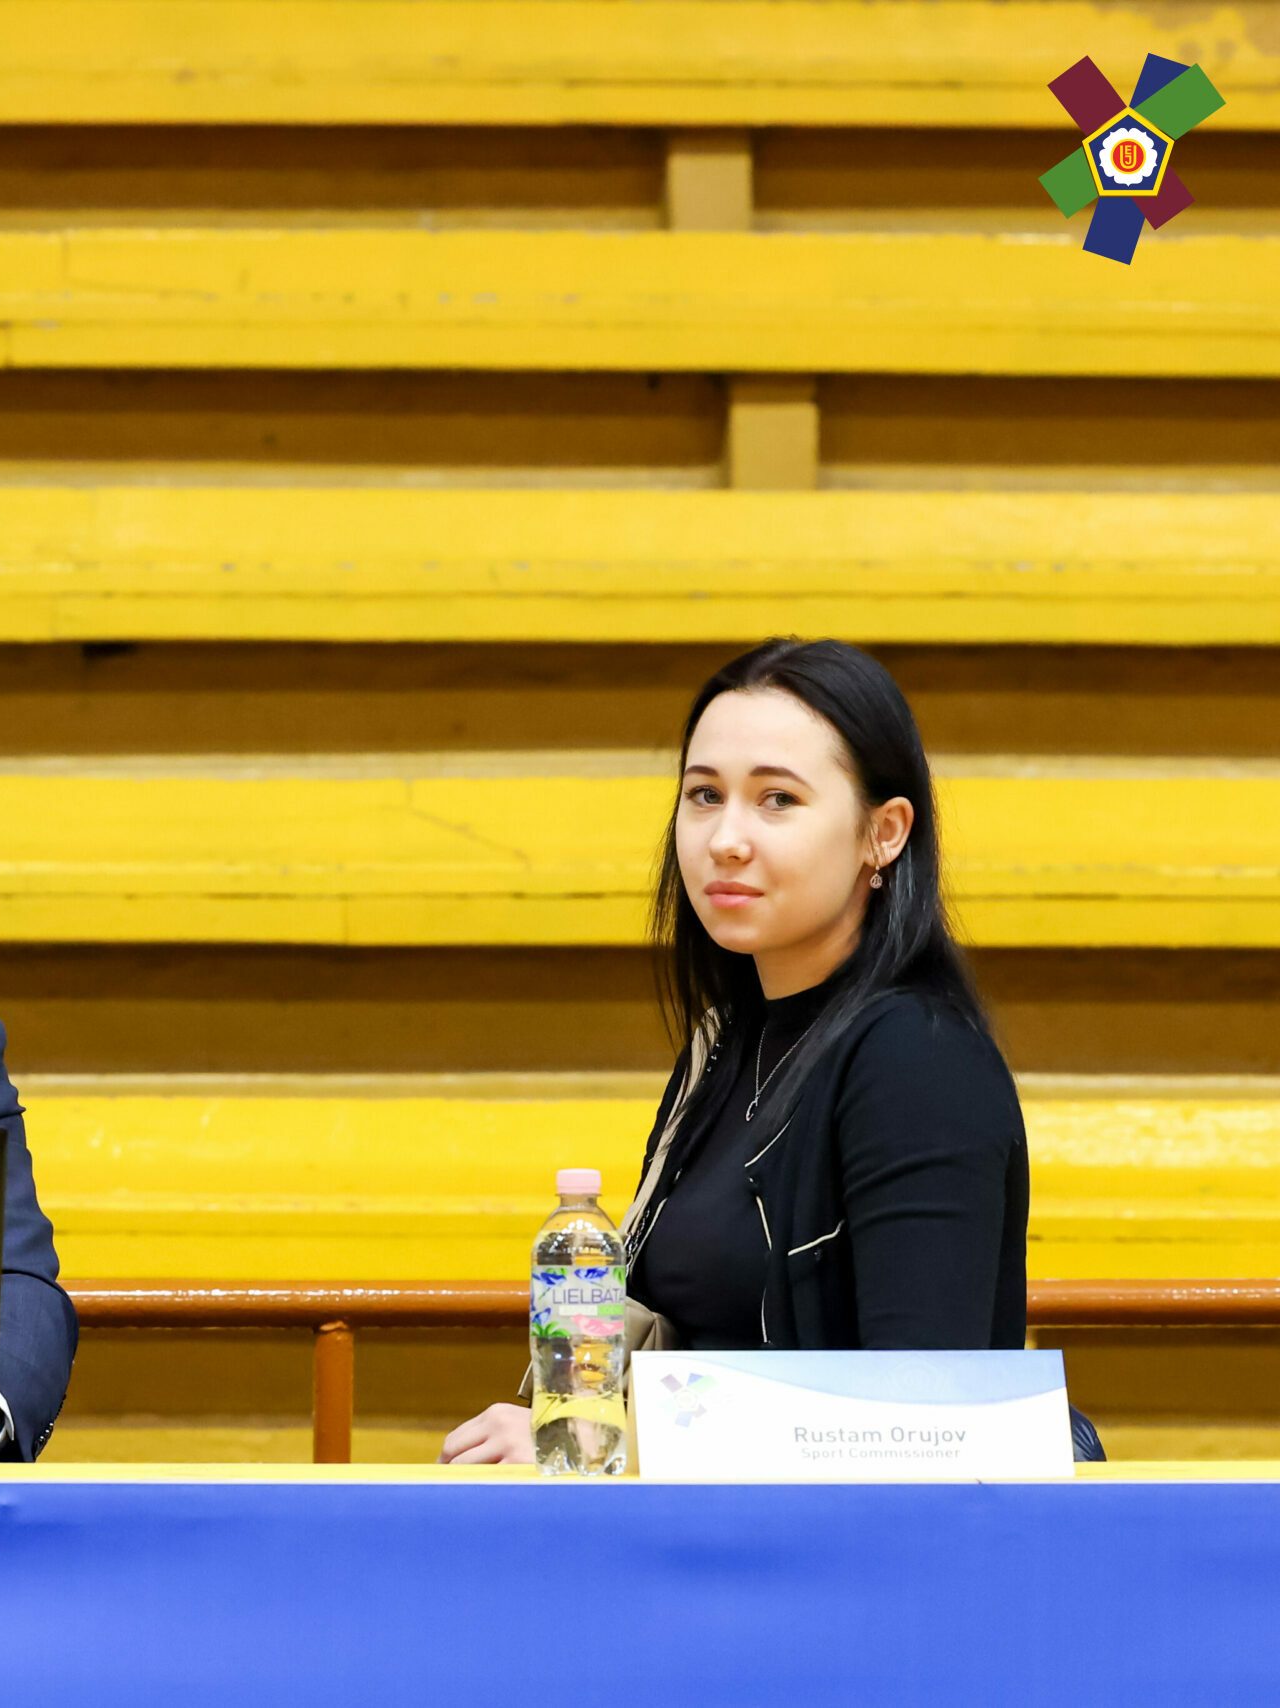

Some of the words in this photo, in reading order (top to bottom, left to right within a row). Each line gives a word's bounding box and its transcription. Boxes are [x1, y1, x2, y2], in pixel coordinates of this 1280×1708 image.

[794, 1426, 882, 1443] Rustam
[890, 1426, 966, 1446] Orujov
[801, 1447, 844, 1460] Sport
[848, 1447, 961, 1459] Commissioner
